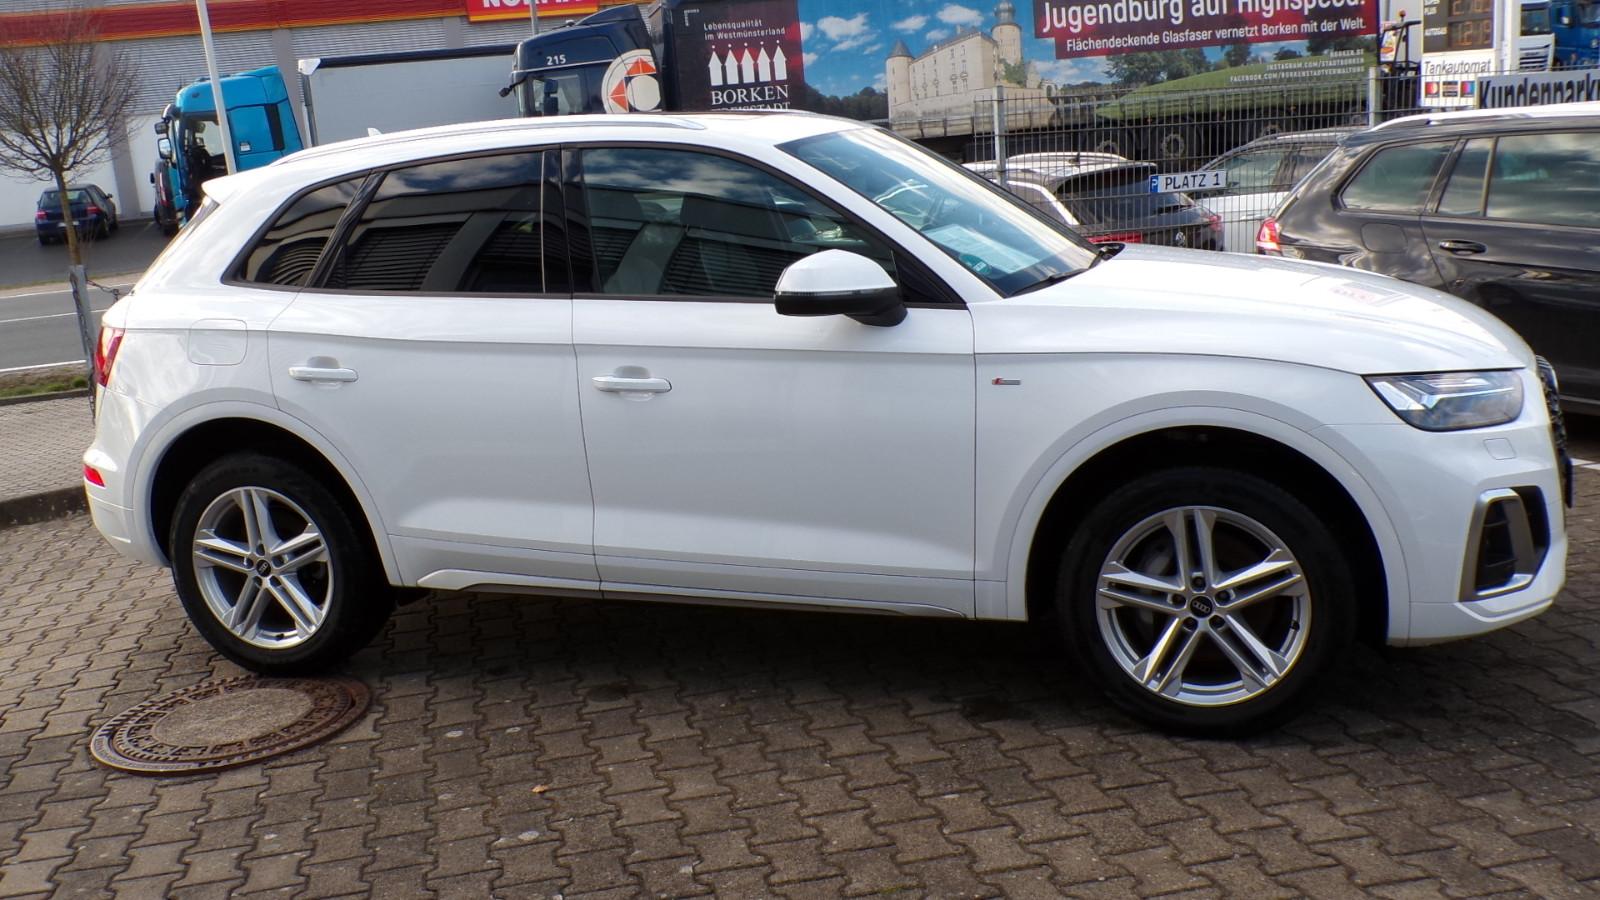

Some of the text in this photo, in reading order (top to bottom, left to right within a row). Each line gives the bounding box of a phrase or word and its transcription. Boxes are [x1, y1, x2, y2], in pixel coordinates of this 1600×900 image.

[1043, 0, 1184, 33] Jugendburg
[704, 20, 762, 31] Lebensqualität
[704, 27, 786, 41] im Westmünsterland
[1066, 18, 1366, 52] Flächendeckende Glasfaser vernetzt Borken mit der Welt.
[546, 54, 567, 66] 215
[1425, 59, 1491, 74] Tankautomat
[711, 85, 789, 105] BORKEN
[1478, 72, 1600, 109] Kundenpark
[1165, 174, 1206, 190] PLATZ
[1213, 173, 1220, 186] 1
